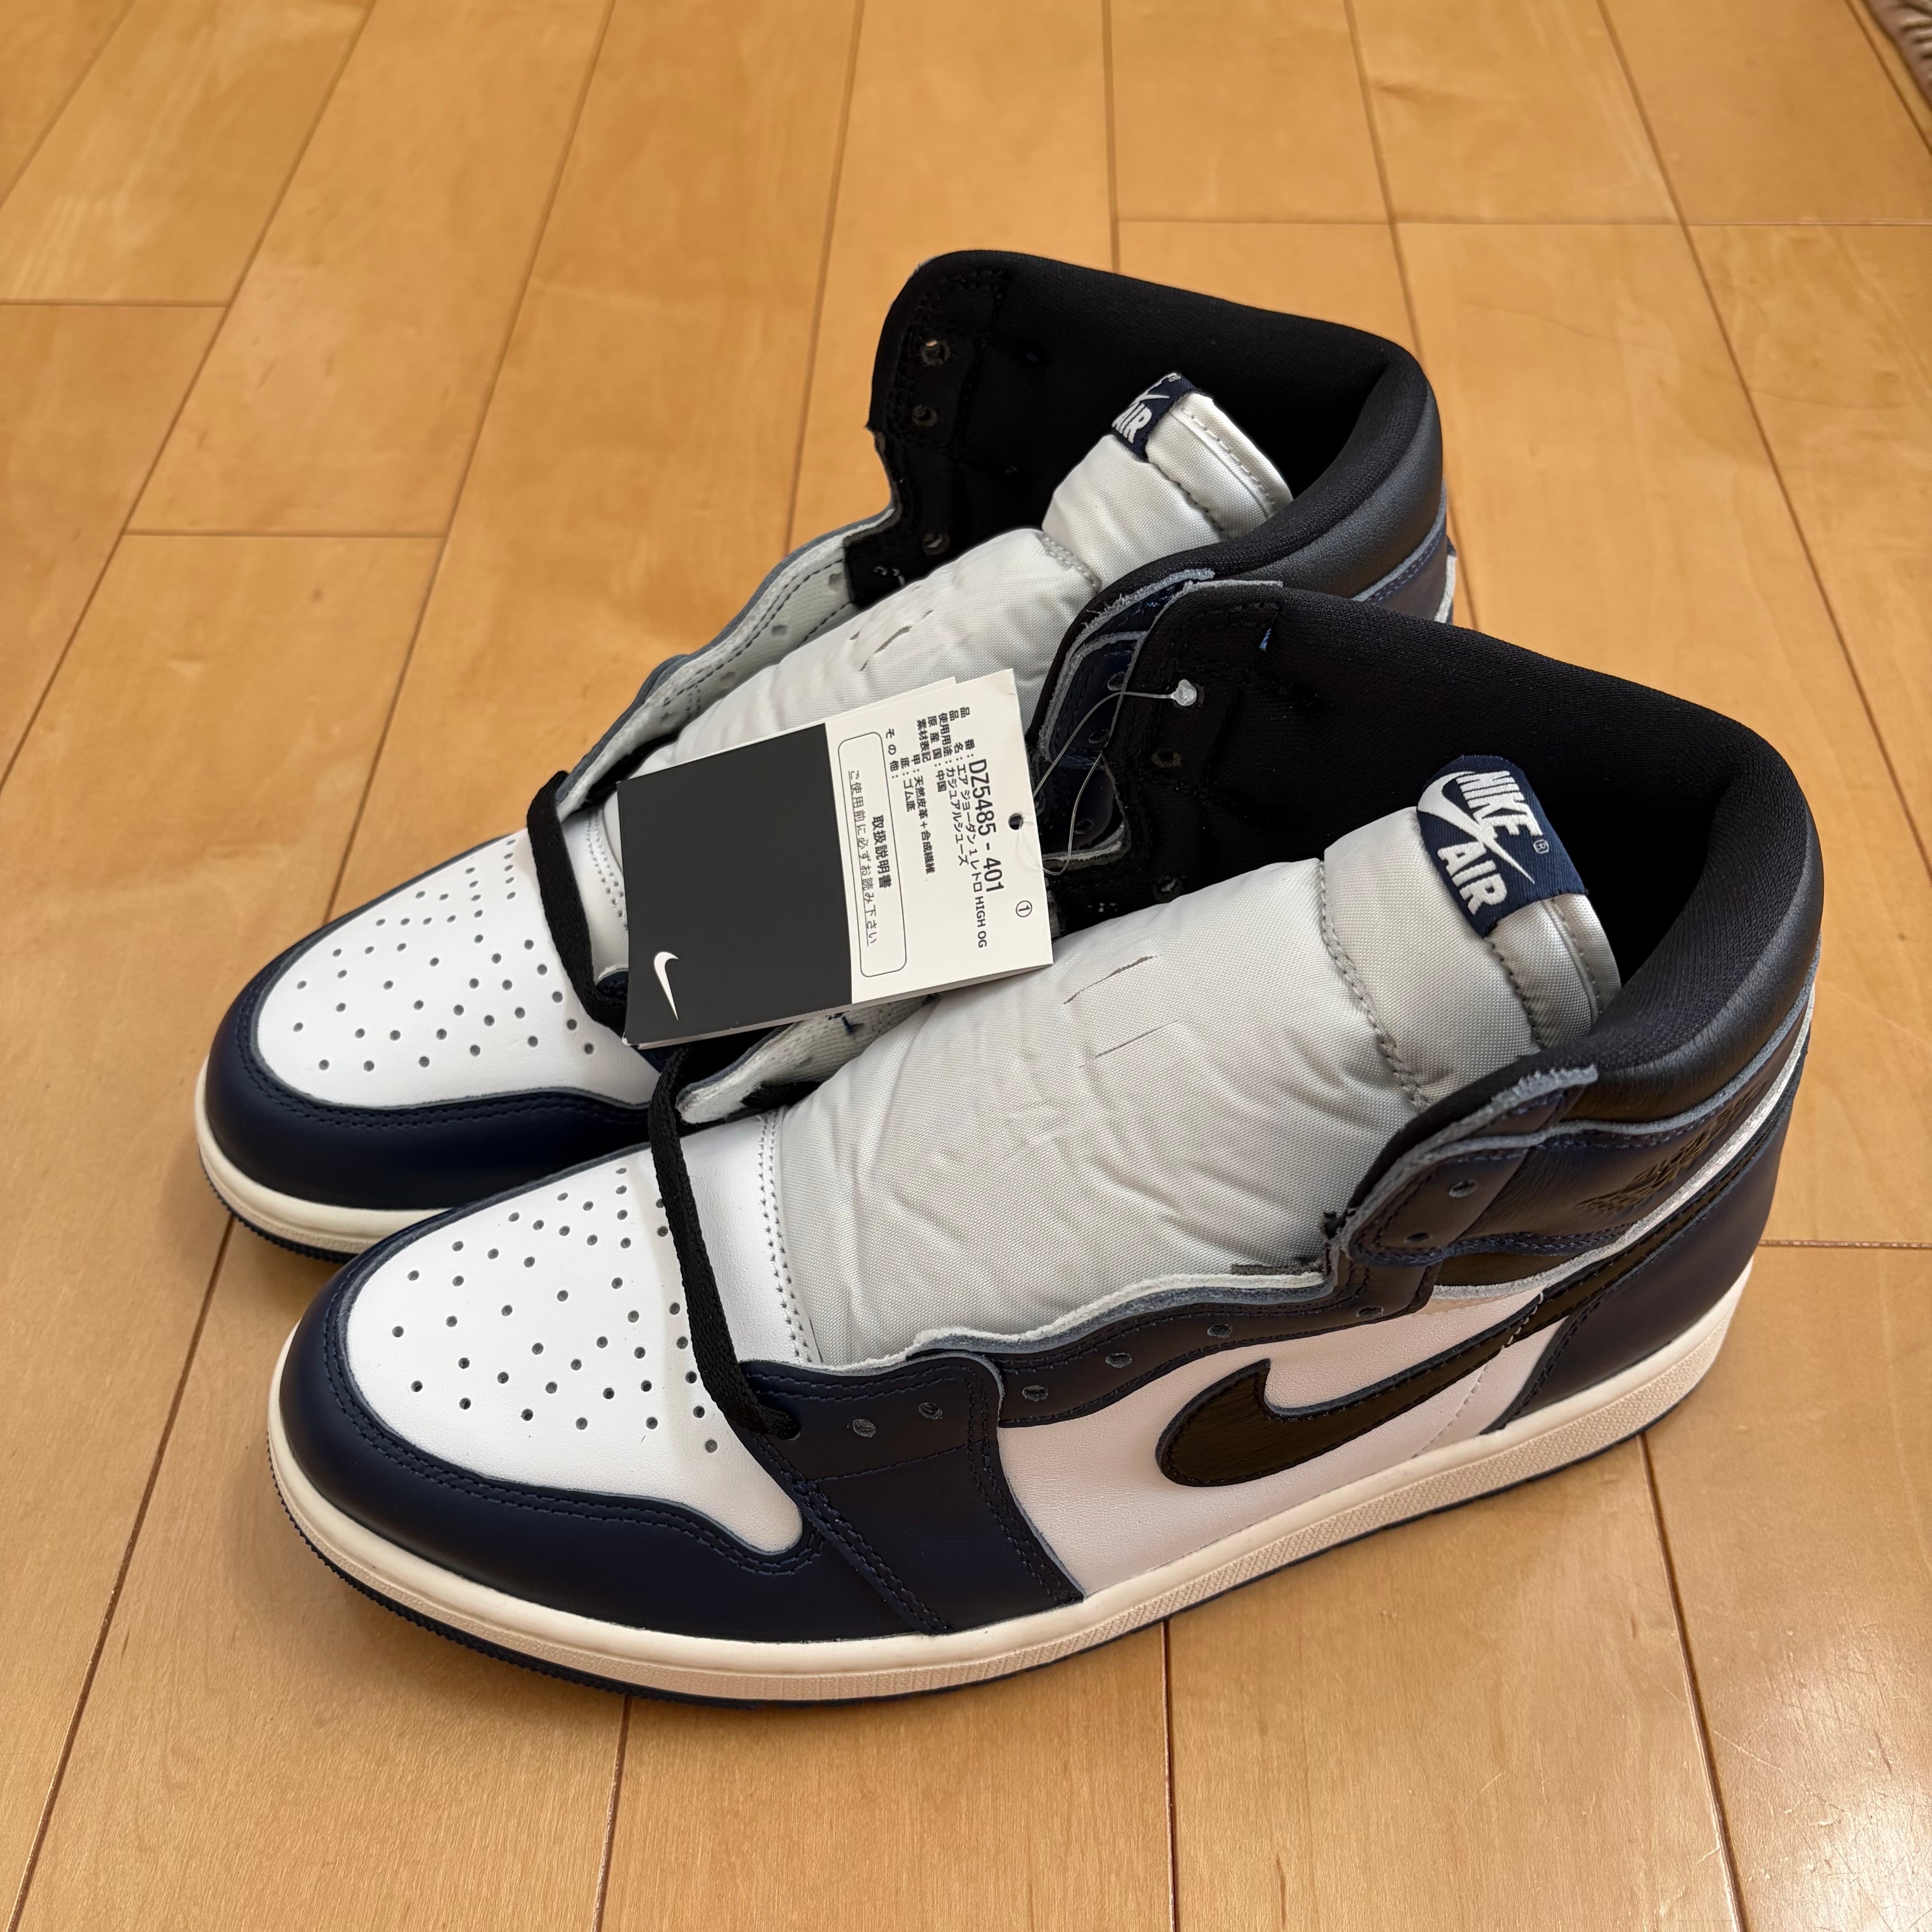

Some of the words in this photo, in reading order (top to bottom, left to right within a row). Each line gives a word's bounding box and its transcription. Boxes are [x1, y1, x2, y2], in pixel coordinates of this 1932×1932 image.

[917, 718, 931, 763] 素材表記
[1455, 770, 1543, 838] NIKE
[850, 770, 877, 944] ご使用前に必ずお読み下さい
[872, 814, 892, 889] 取扱説明書
[983, 857, 1004, 892] 401
[1437, 842, 1508, 915] AIR
[975, 896, 986, 928] HIGH
[977, 930, 987, 948] OG
